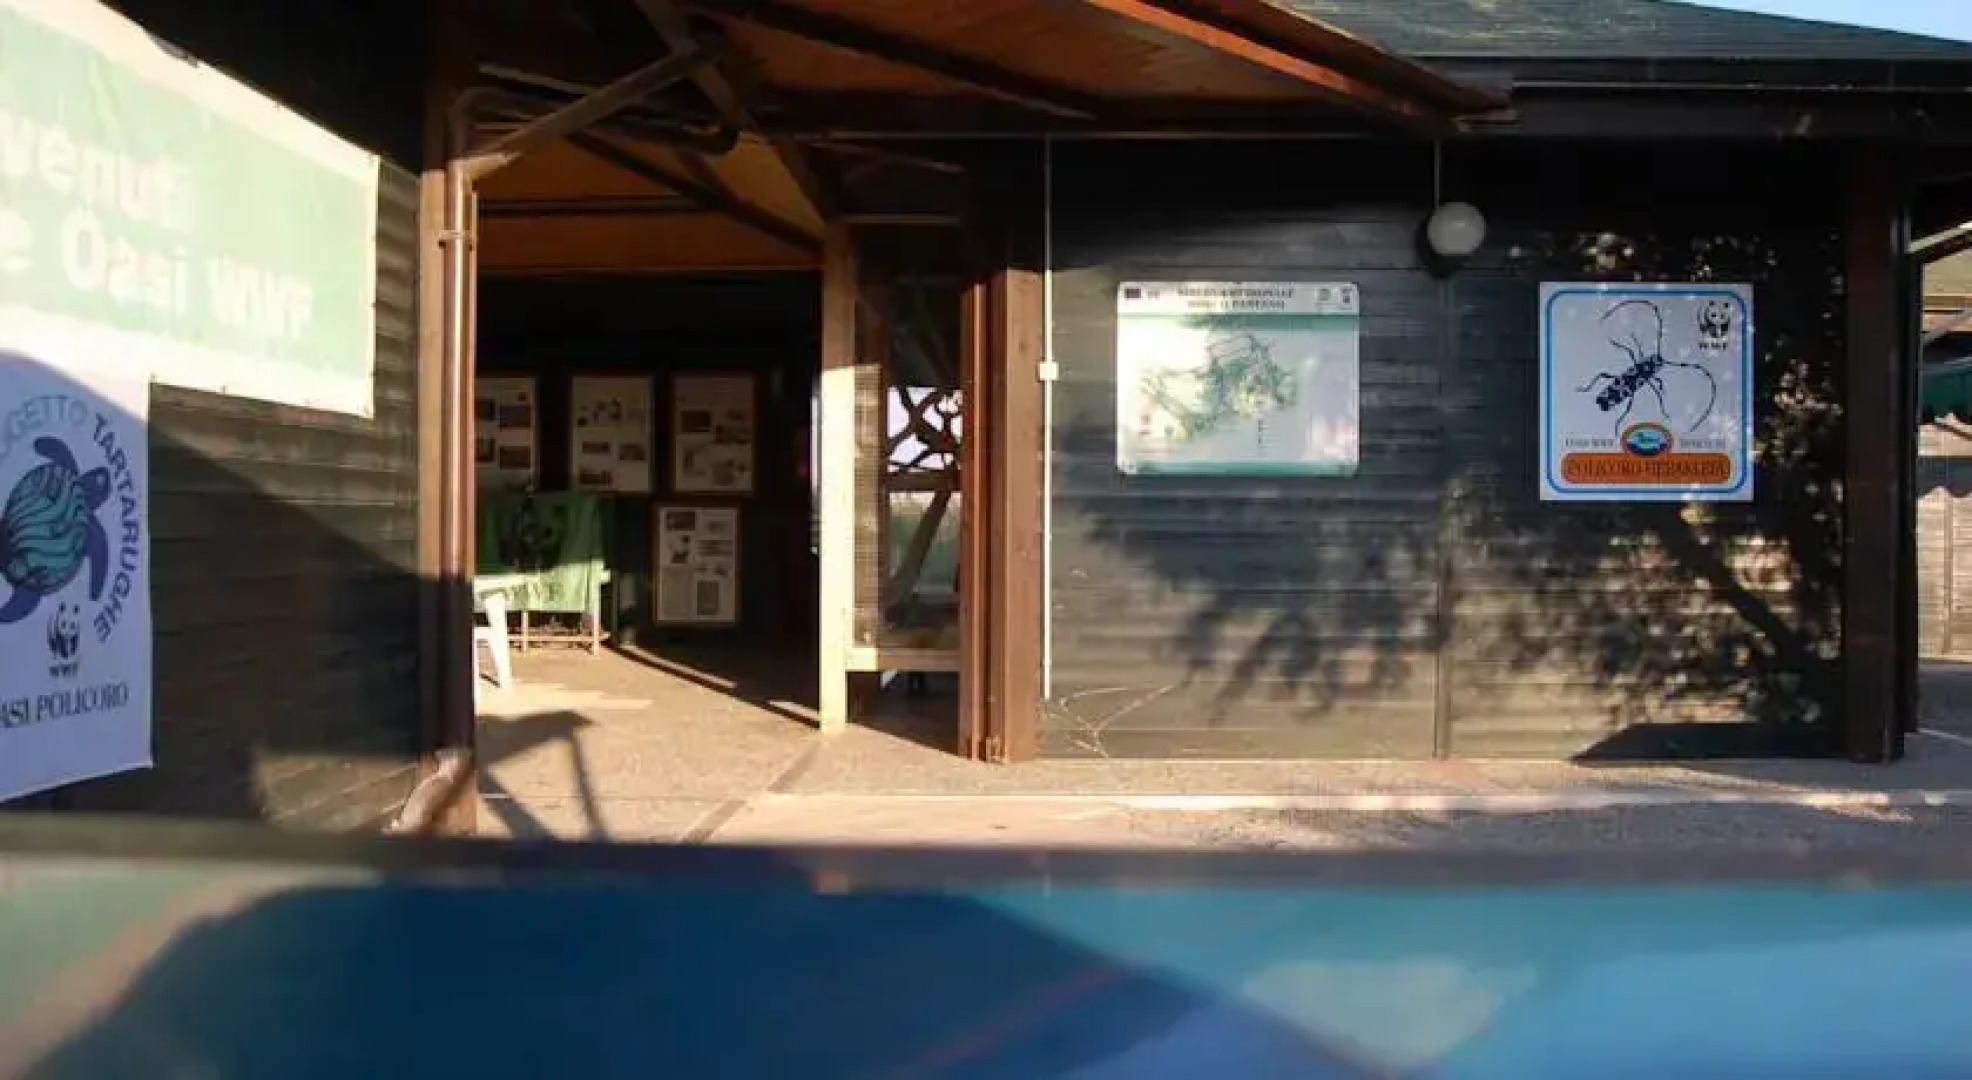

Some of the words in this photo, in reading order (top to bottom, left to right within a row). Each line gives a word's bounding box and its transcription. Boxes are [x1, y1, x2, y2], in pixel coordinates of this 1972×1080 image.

[61, 205, 188, 316] Oasi
[94, 412, 140, 644] TARTARUGHE
[36, 680, 129, 721] POLICORO
[47, 661, 79, 679] WWF
